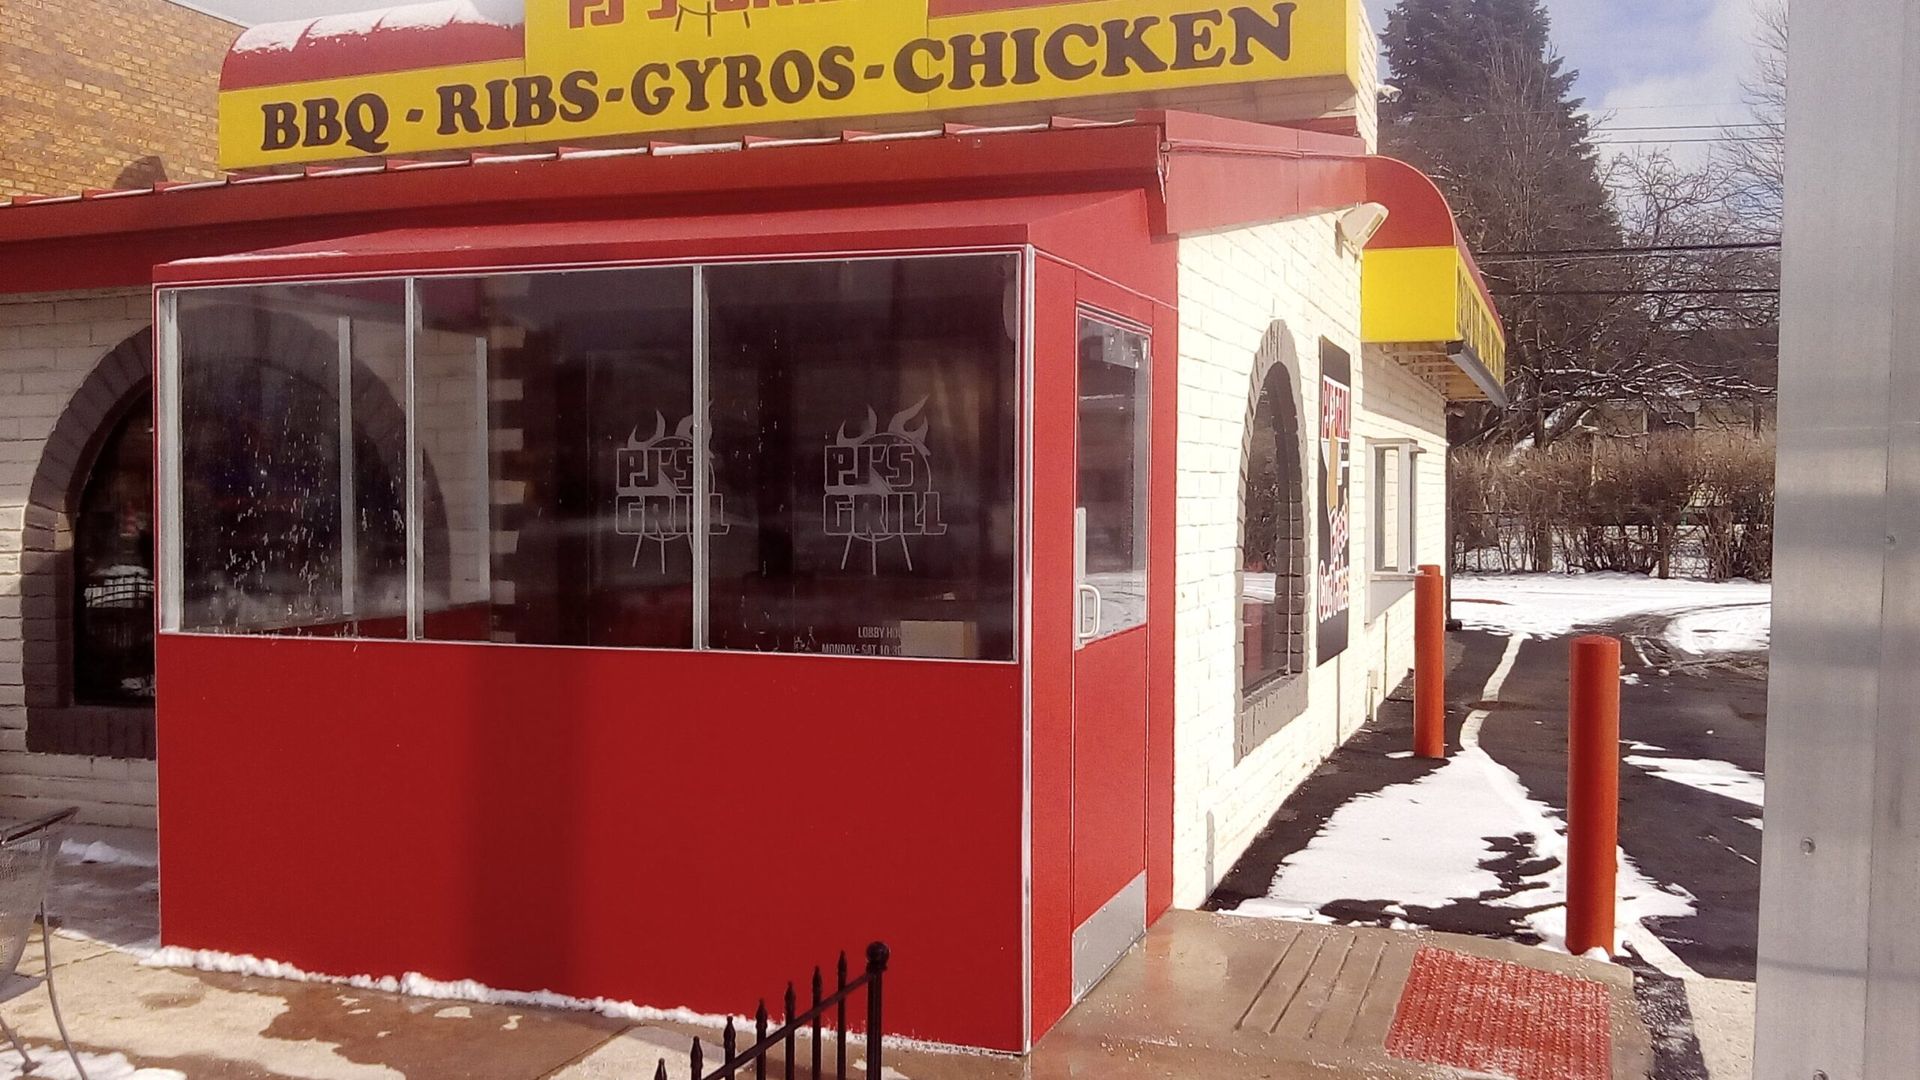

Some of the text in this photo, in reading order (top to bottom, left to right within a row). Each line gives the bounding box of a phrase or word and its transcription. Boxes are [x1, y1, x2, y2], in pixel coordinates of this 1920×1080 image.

[824, 443, 916, 489] PJ'S
[823, 492, 948, 536] GRILL
[858, 626, 885, 639] LOBBY
